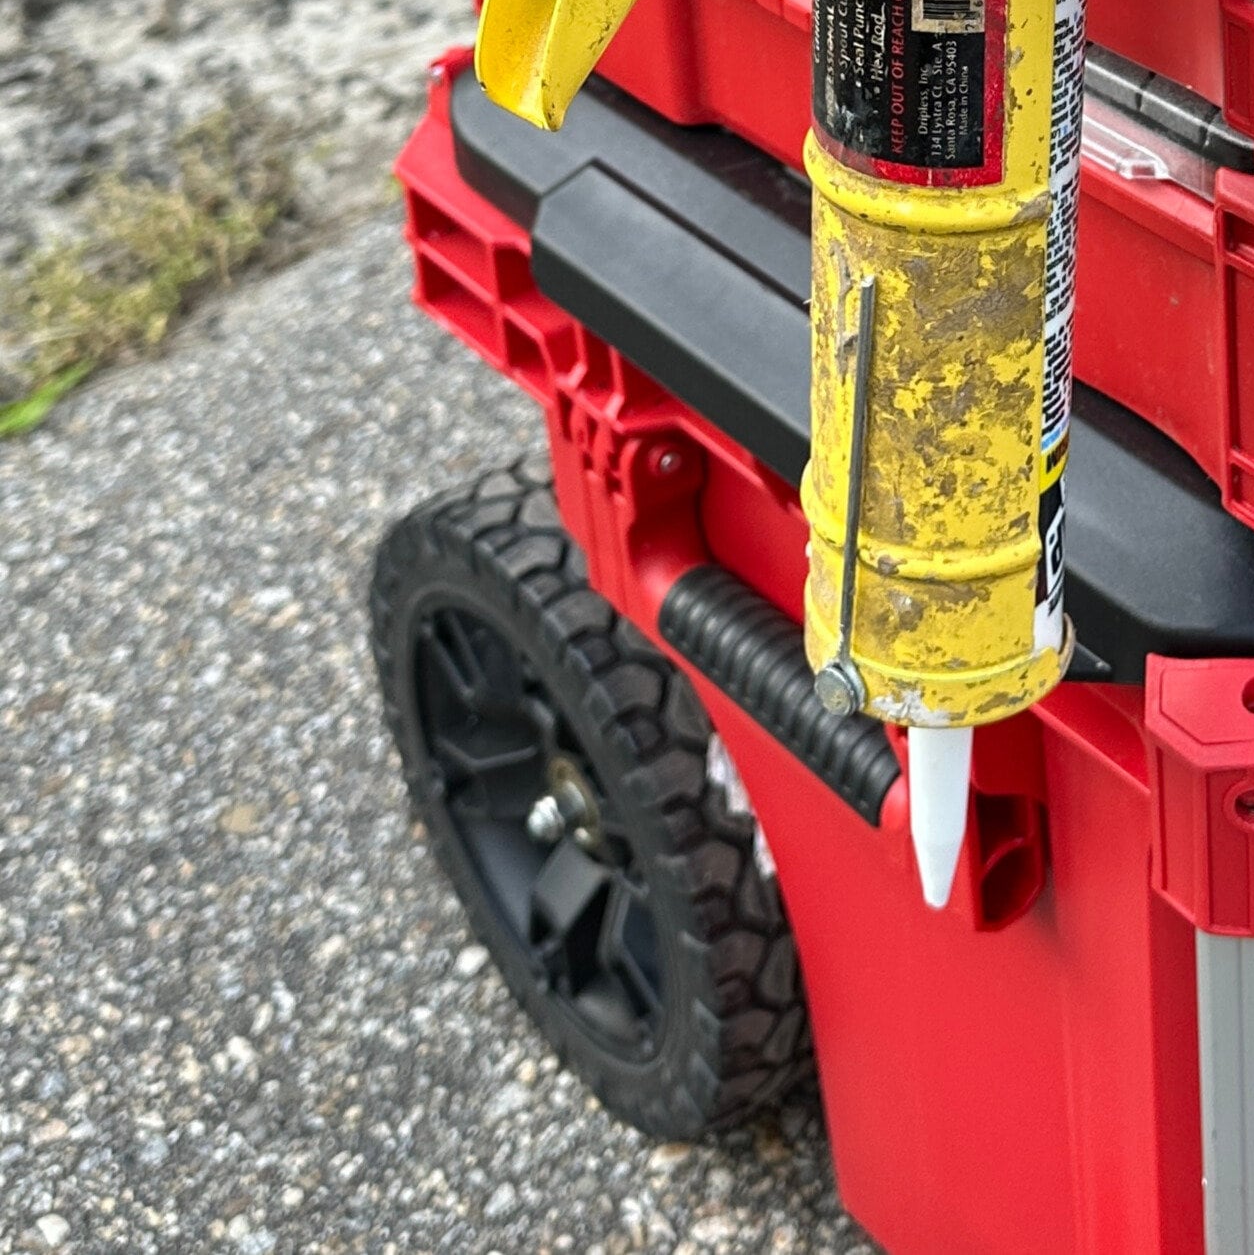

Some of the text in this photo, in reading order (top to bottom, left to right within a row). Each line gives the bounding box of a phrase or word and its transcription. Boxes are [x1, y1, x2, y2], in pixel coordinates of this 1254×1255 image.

[838, 21, 850, 70] Spout
[870, 13, 883, 82] Hex Rod
[891, 6, 904, 56] REACH
[932, 42, 942, 51] A
[853, 41, 864, 76] Seal
[891, 58, 904, 79] OF
[945, 40, 957, 75] 95403
[891, 82, 904, 115] OUT
[945, 77, 956, 94] CA
[959, 66, 969, 135] Made in China
[931, 101, 944, 134] Lystra
[891, 118, 905, 154] KEEP
[931, 137, 942, 156] 134
[945, 129, 956, 160] Santa
